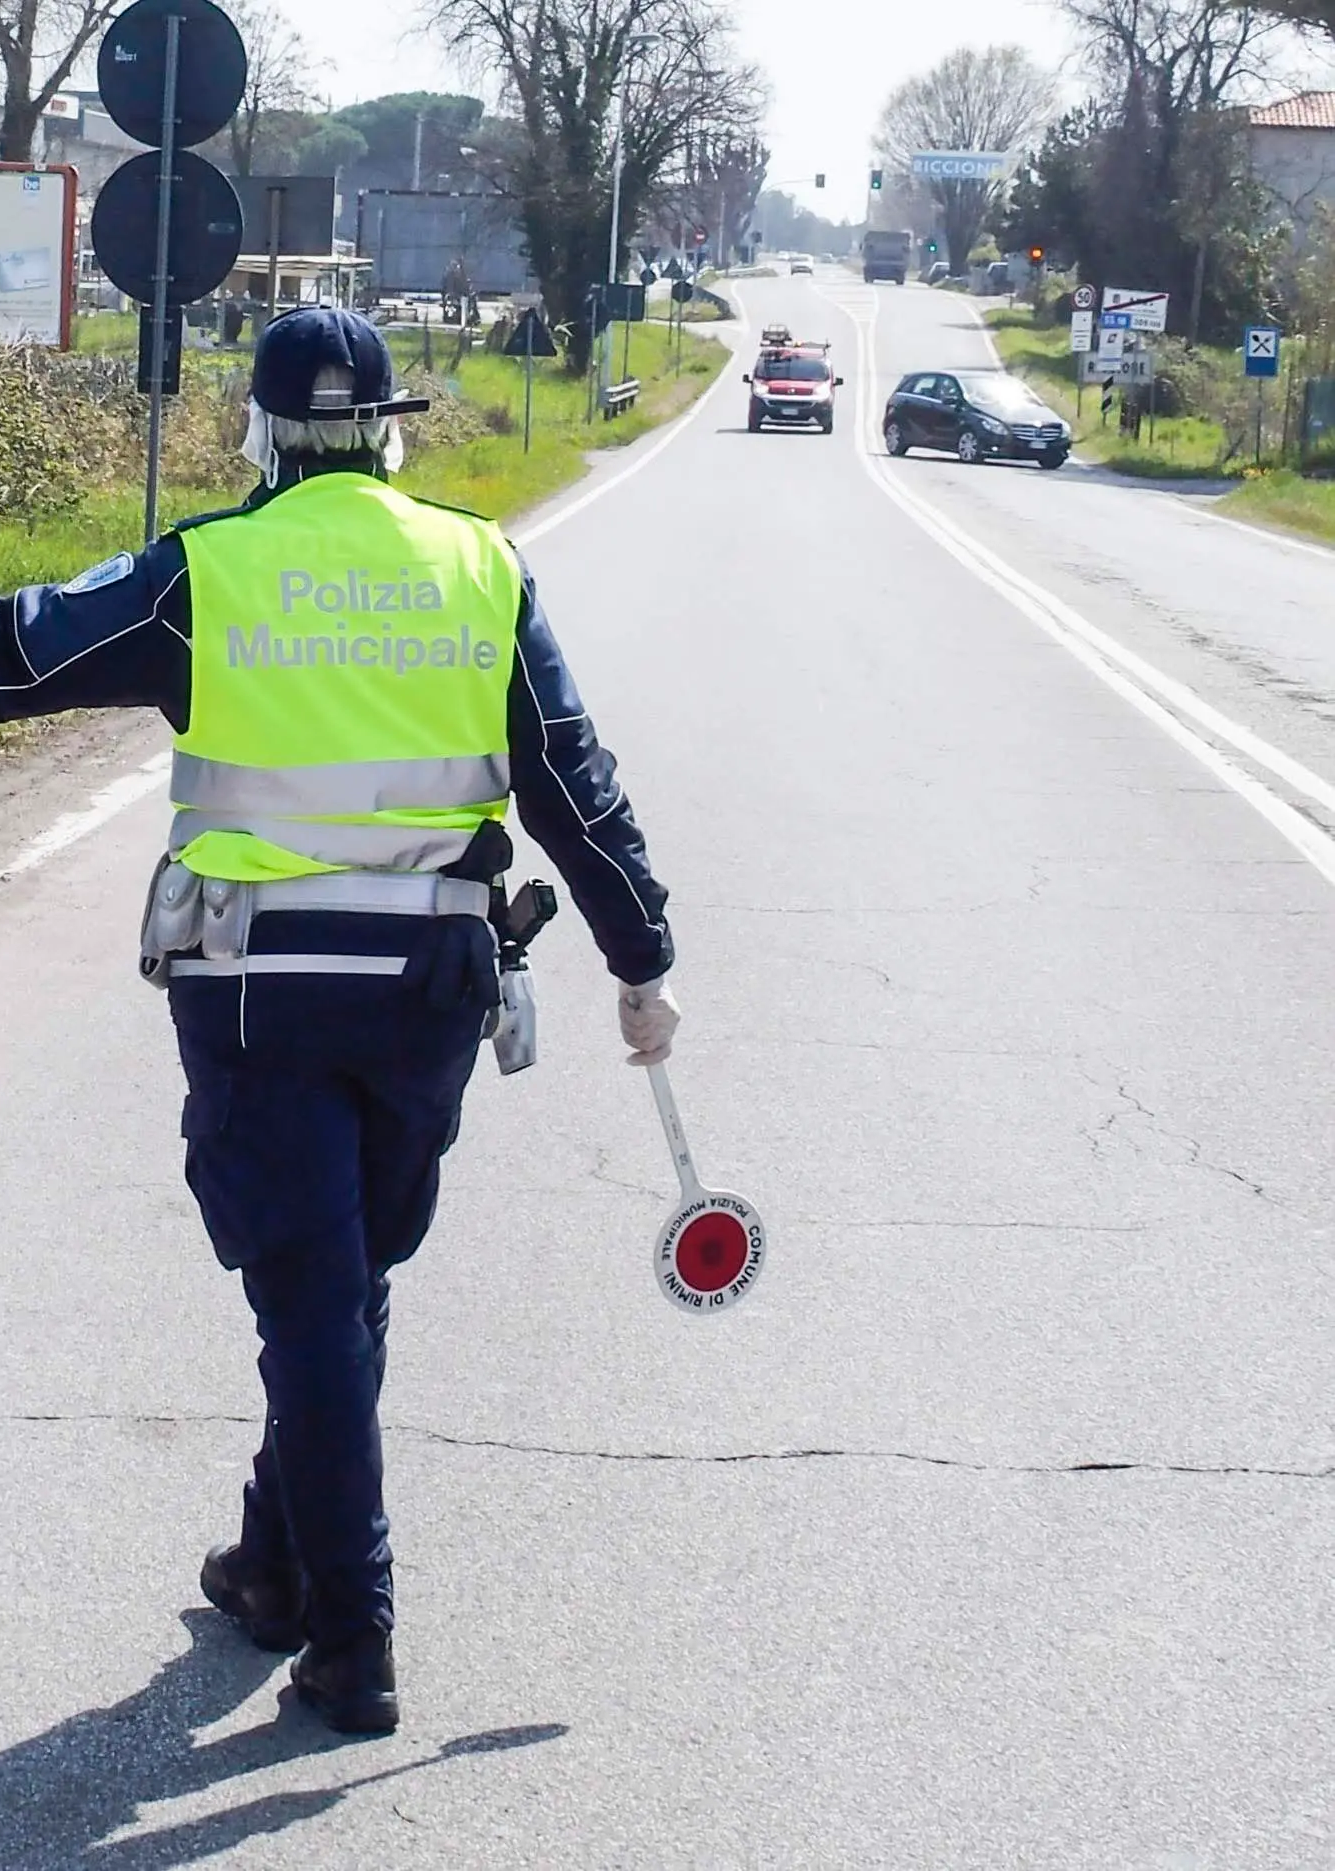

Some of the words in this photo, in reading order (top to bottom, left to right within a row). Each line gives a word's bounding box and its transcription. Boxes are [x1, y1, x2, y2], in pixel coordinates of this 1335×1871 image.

[913, 159, 1002, 176] RICCIONE
[1077, 291, 1090, 304] 50
[279, 568, 443, 614] Polizia
[226, 622, 498, 676] Municipale
[709, 1197, 751, 1219] POLIZIA
[661, 1201, 707, 1261] MUNICIPALE
[729, 1225, 762, 1297] COMUNE
[663, 1271, 704, 1308] RIMINI
[709, 1293, 724, 1308] DI
